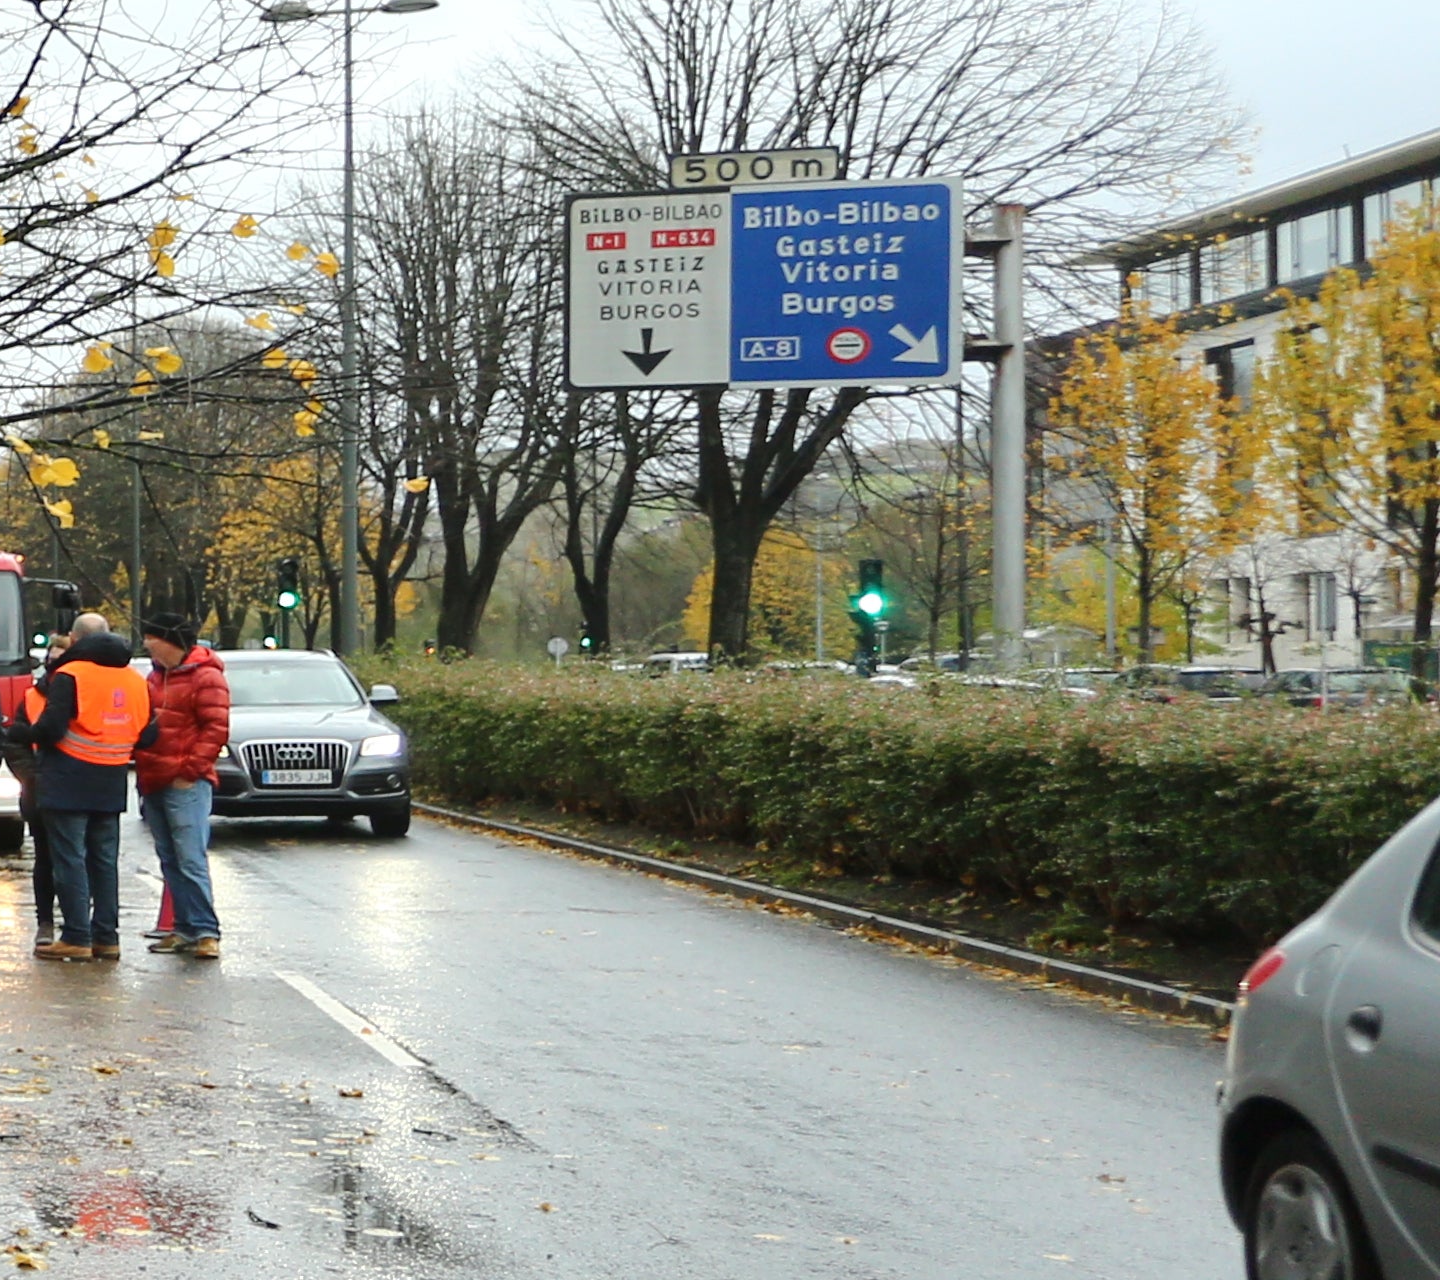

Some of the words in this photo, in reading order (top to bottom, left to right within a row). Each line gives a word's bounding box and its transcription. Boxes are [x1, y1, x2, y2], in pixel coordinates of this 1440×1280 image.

[685, 155, 774, 183] 500
[791, 156, 824, 178] m
[743, 201, 940, 229] Bilbo-Bilbao
[656, 231, 711, 245] N-634
[776, 232, 905, 257] Gasteiz
[780, 258, 900, 283] Vitoria
[599, 279, 702, 296] VITORIA
[600, 303, 701, 321] BURGOS
[782, 292, 896, 318] Burgos
[747, 339, 791, 358] A-8
